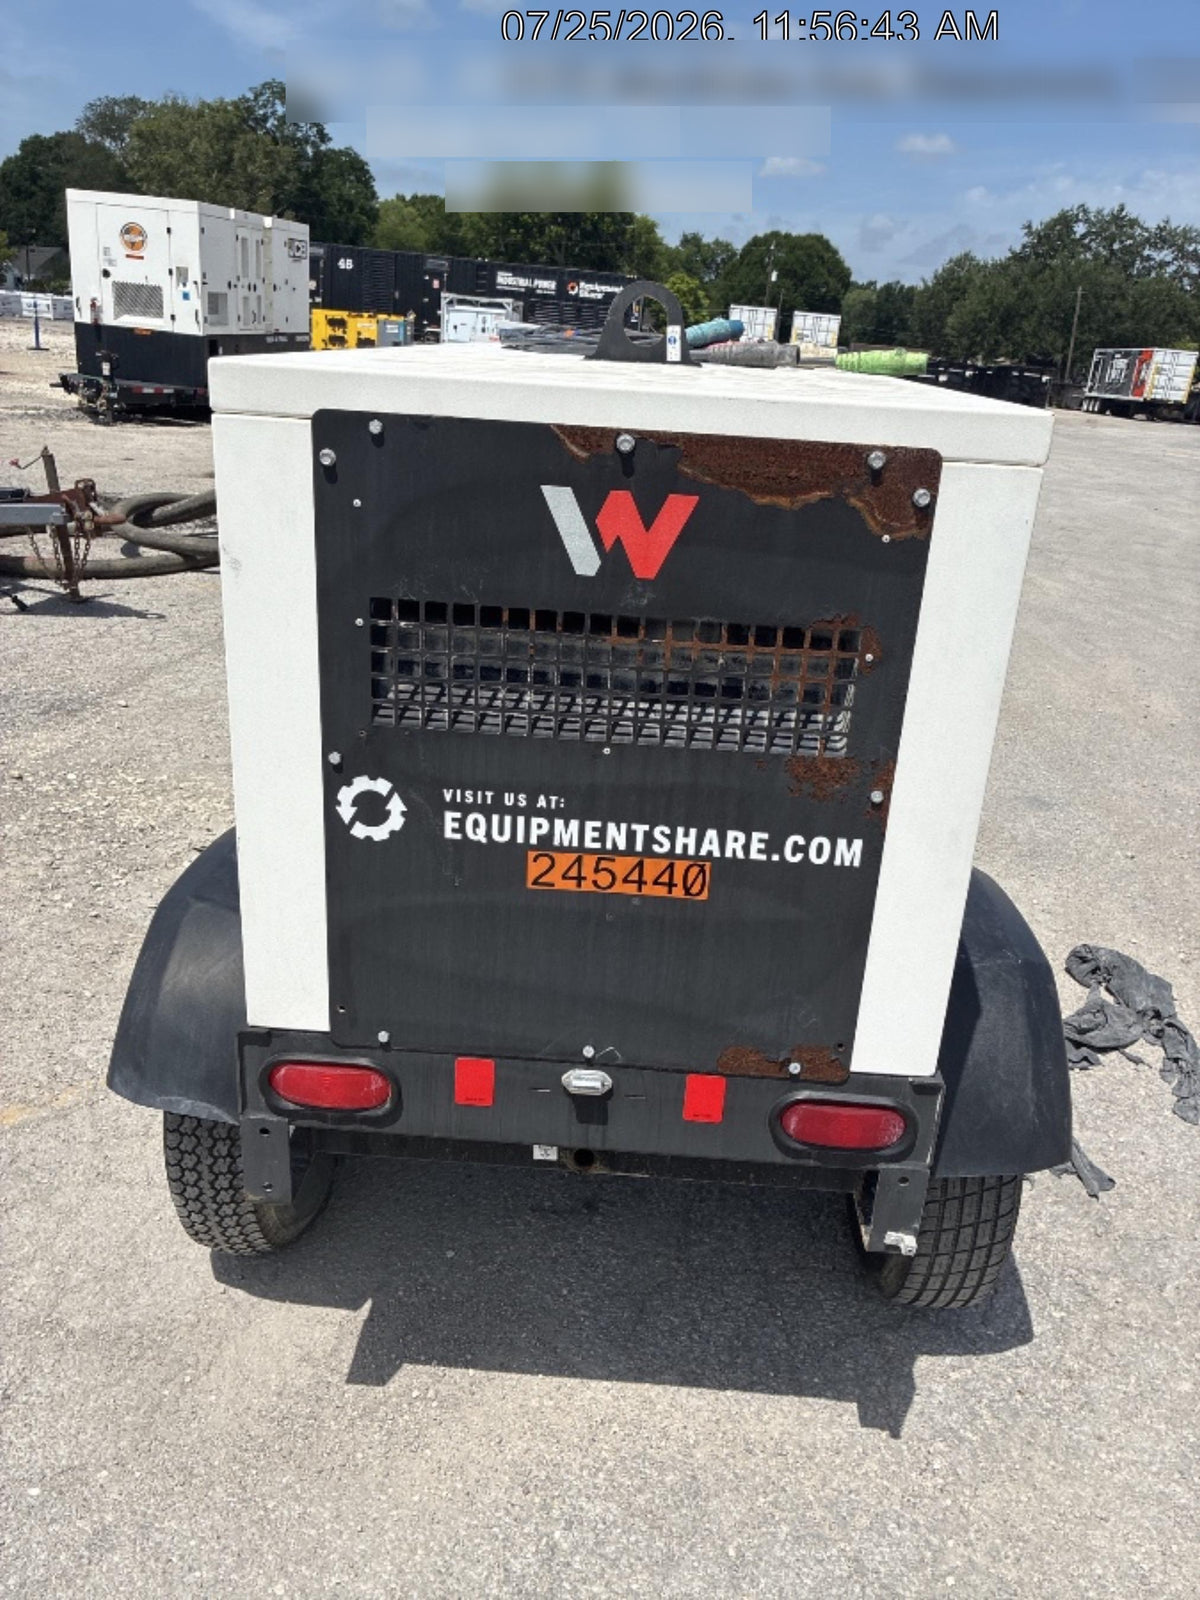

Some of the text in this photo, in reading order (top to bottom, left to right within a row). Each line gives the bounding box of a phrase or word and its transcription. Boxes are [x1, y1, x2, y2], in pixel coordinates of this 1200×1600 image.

[442, 788, 566, 810] VISIT US AT:
[443, 810, 864, 868] EQUIPMENTSHARE.COM
[531, 852, 708, 898] 245440
